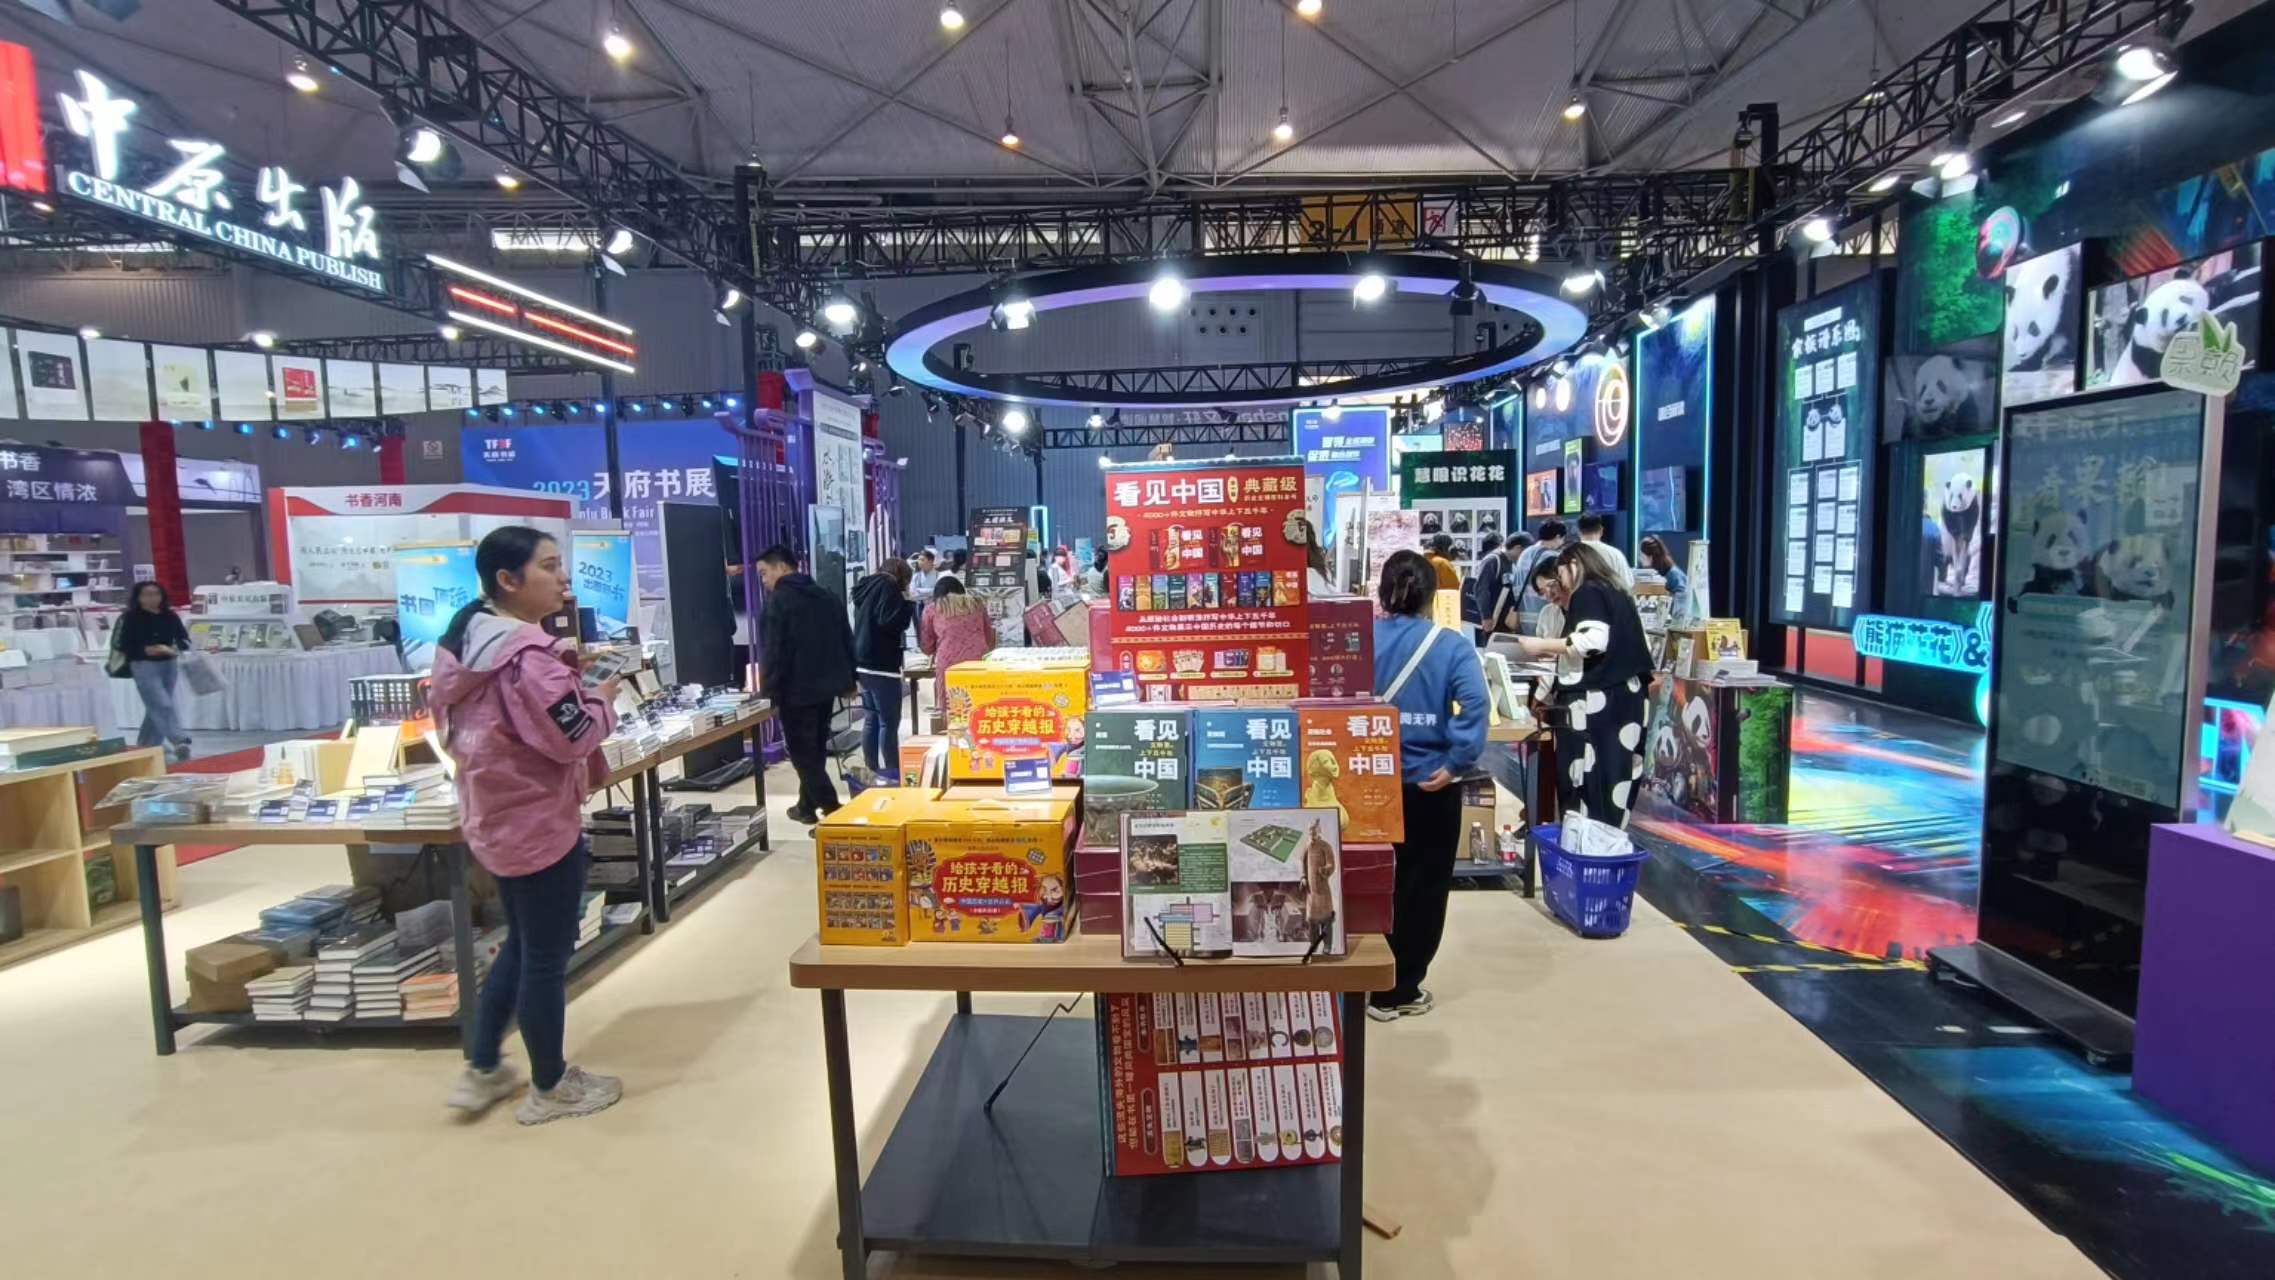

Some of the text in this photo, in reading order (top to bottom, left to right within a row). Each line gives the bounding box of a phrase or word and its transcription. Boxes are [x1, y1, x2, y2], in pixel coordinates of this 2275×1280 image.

[57, 68, 380, 260] 中原出版
[67, 171, 383, 290] CENTRAL CHINA PUBLISH
[7, 479, 98, 502] 湾区情浓
[593, 467, 716, 499] 天府书展
[1114, 478, 1224, 507] 看见中国
[1244, 476, 1297, 493] 典藏级
[345, 493, 403, 508] 书香河南
[977, 719, 1055, 735] 历史穿越报
[1134, 719, 1179, 741] 看见
[1246, 718, 1292, 740] 看见
[1347, 715, 1394, 737] 看见
[1134, 757, 1179, 780] 中国
[1247, 756, 1292, 778] 中国
[1348, 753, 1395, 775] 中国
[950, 862, 1018, 874] 给孩子看的
[942, 877, 1028, 895] 历史穿越报
